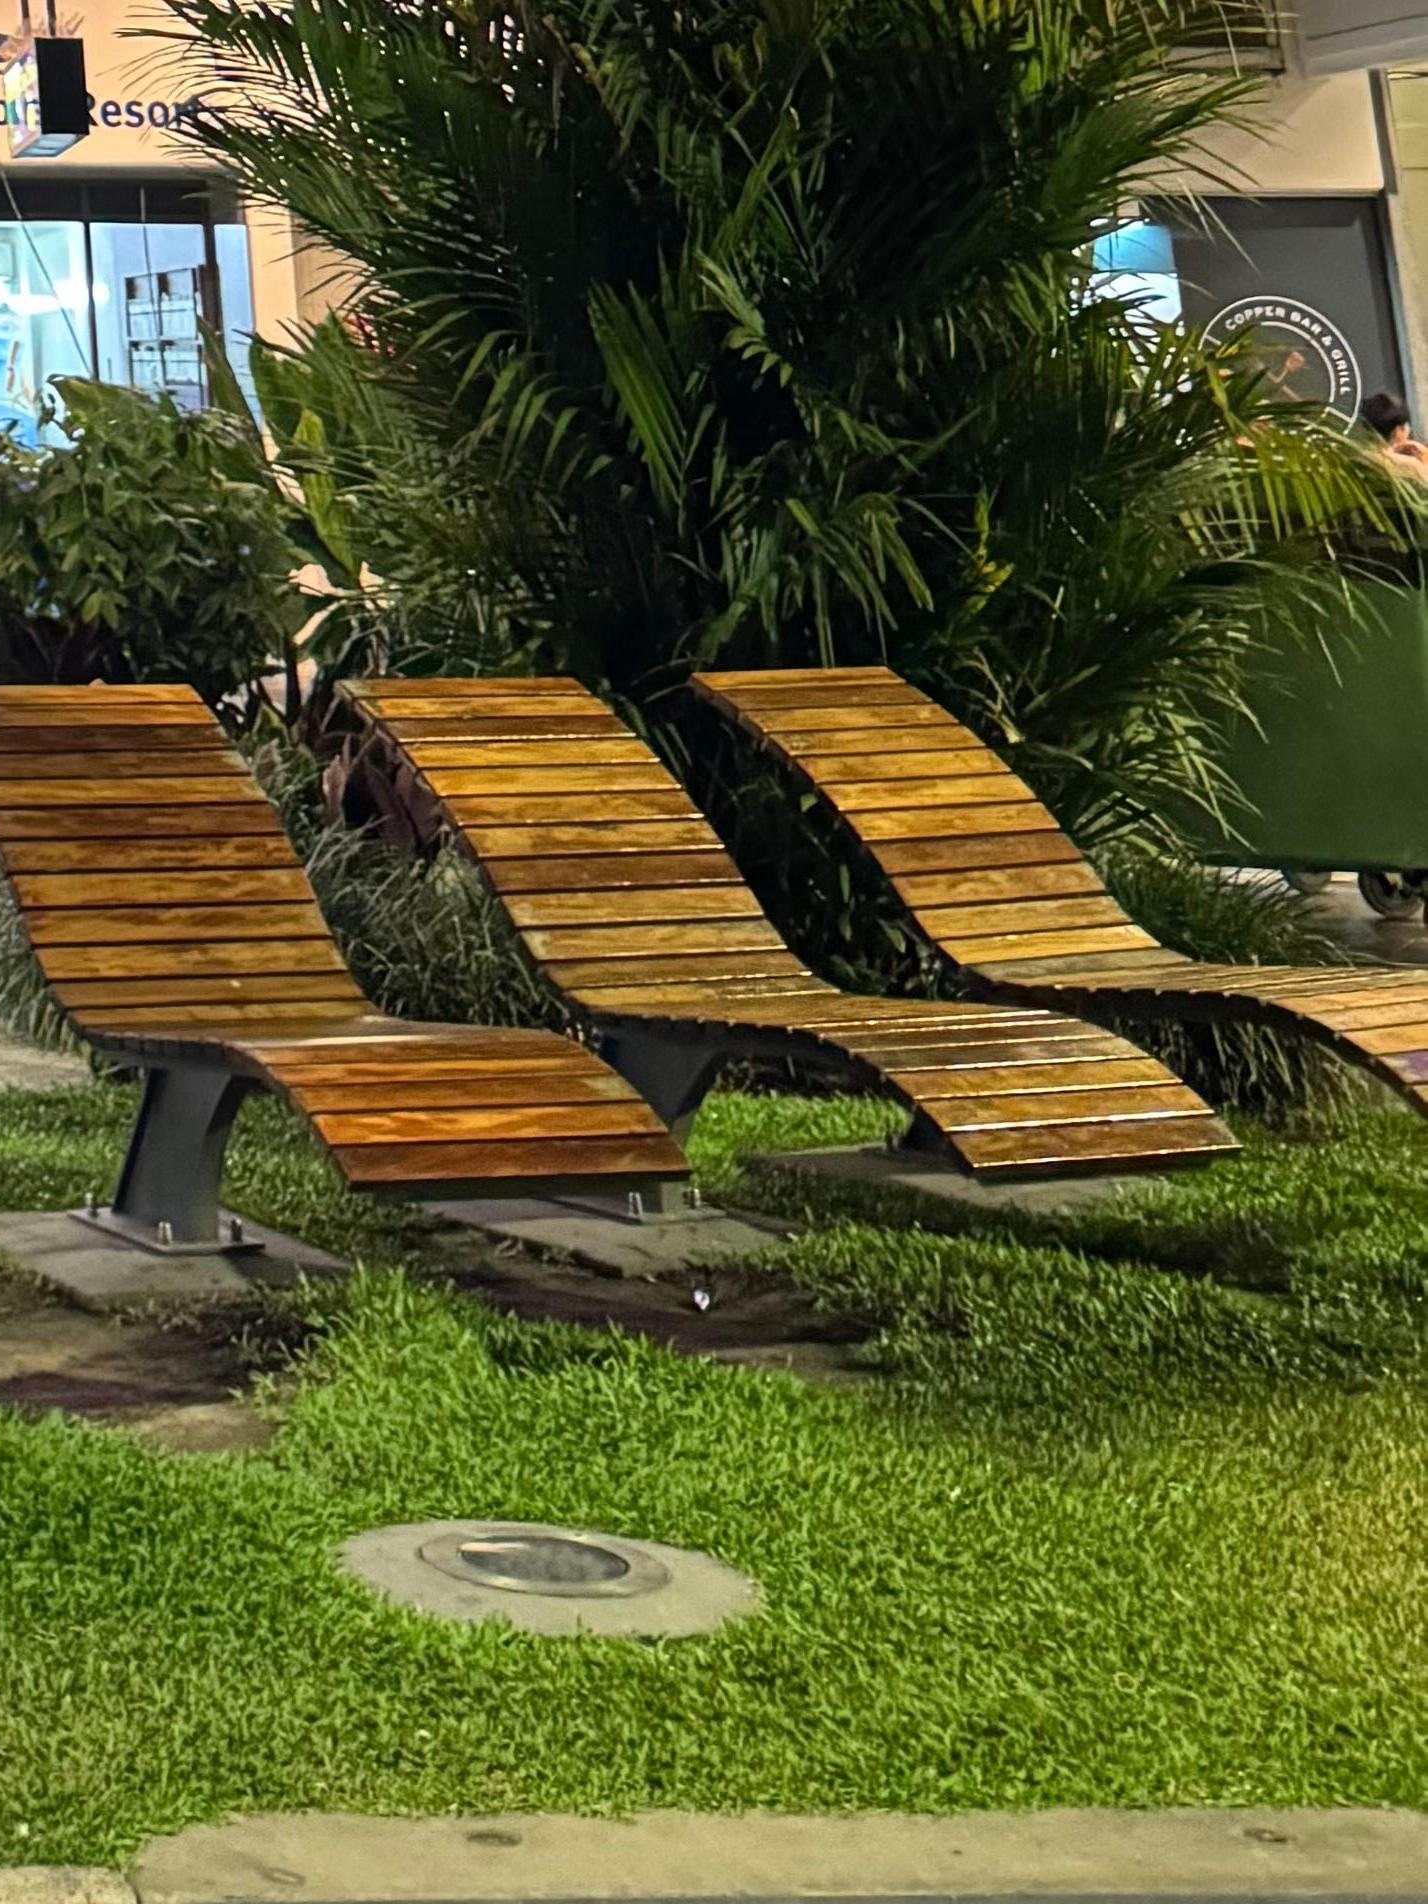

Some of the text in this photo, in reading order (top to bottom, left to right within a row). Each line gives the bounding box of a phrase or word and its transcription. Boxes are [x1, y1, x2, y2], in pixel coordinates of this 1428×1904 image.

[85, 90, 200, 128] esor
[1225, 305, 1286, 331] COPPER
[1290, 311, 1322, 336] BAR
[1331, 348, 1351, 396] GRILL
